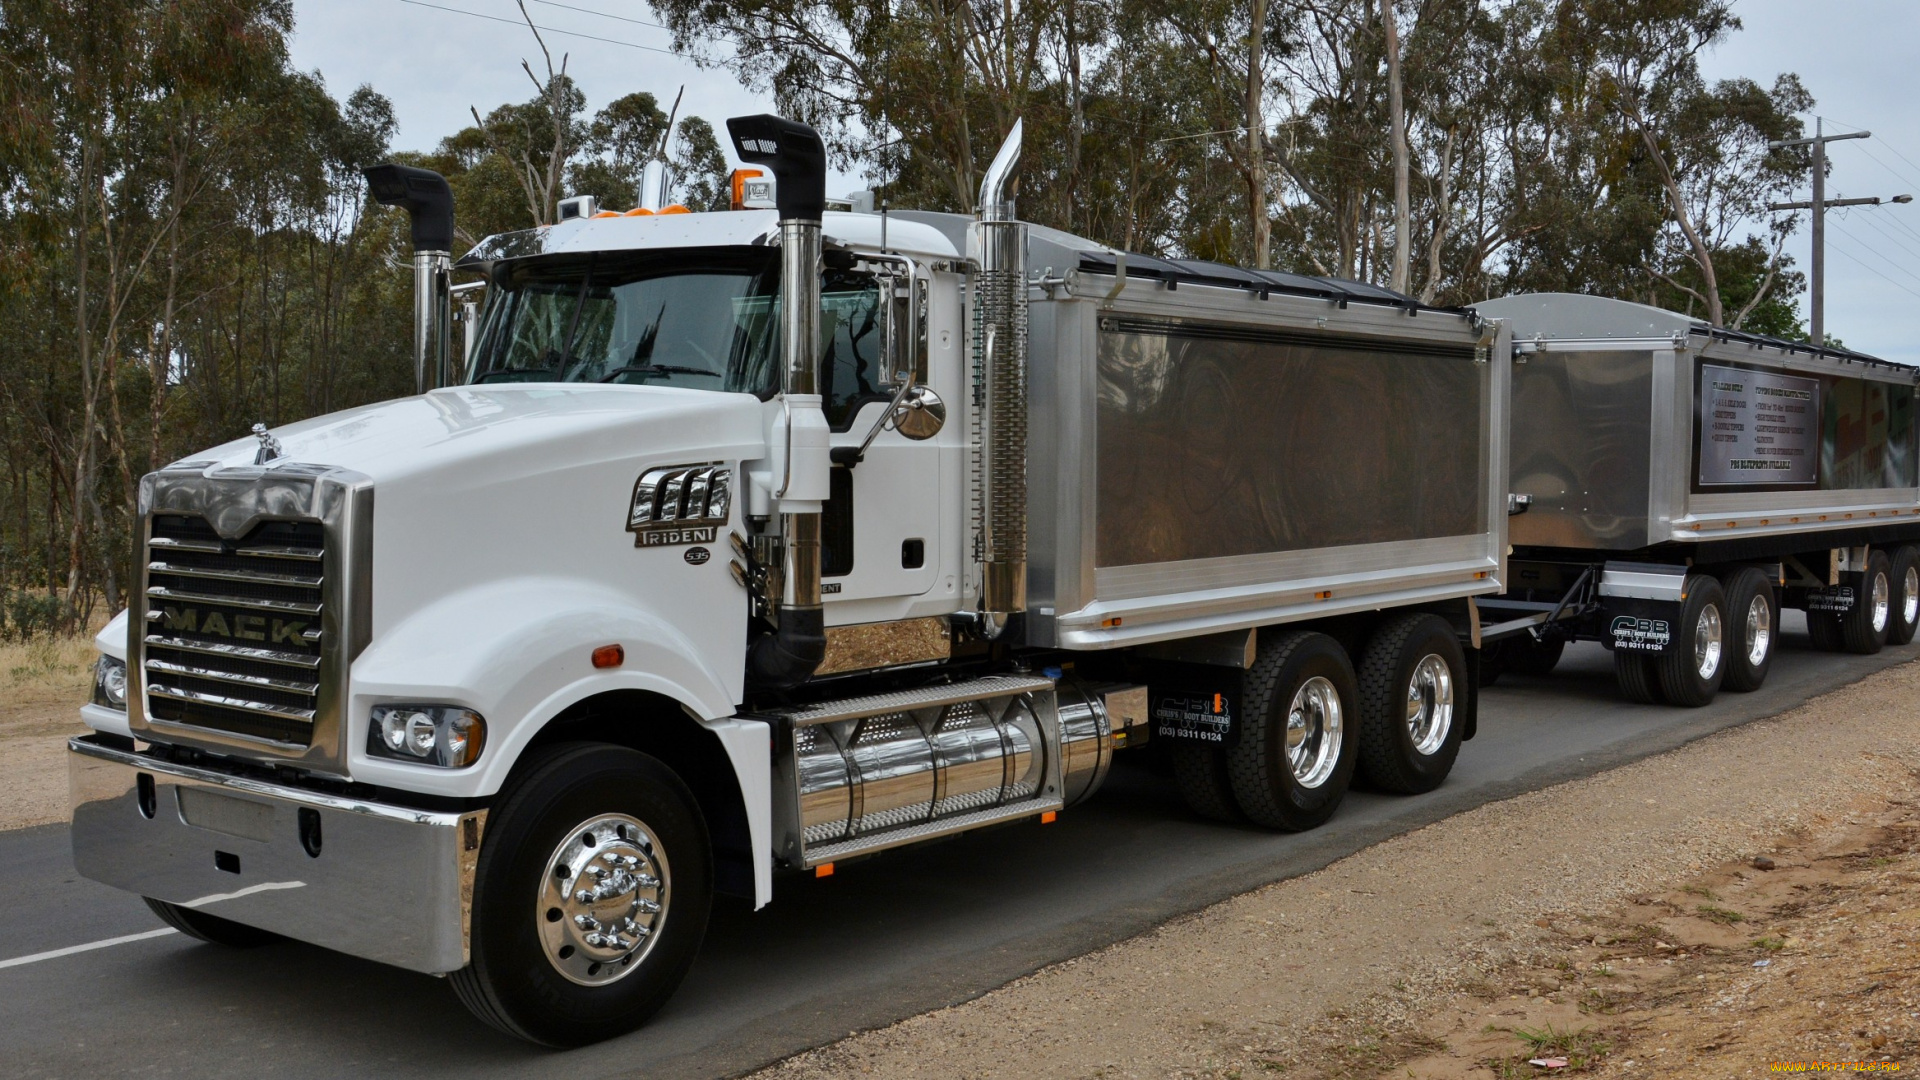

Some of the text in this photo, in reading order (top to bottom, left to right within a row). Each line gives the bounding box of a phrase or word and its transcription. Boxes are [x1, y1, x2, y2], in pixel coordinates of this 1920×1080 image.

[641, 527, 714, 545] TRIDENT
[686, 552, 709, 561] 535
[163, 606, 309, 647] MACK
[1615, 640, 1627, 648] (03)
[1646, 643, 1663, 651] 6124
[1156, 709, 1230, 725] CHRIS'S BODY BUILDERS
[1159, 726, 1222, 742] (03) 9311 6124
